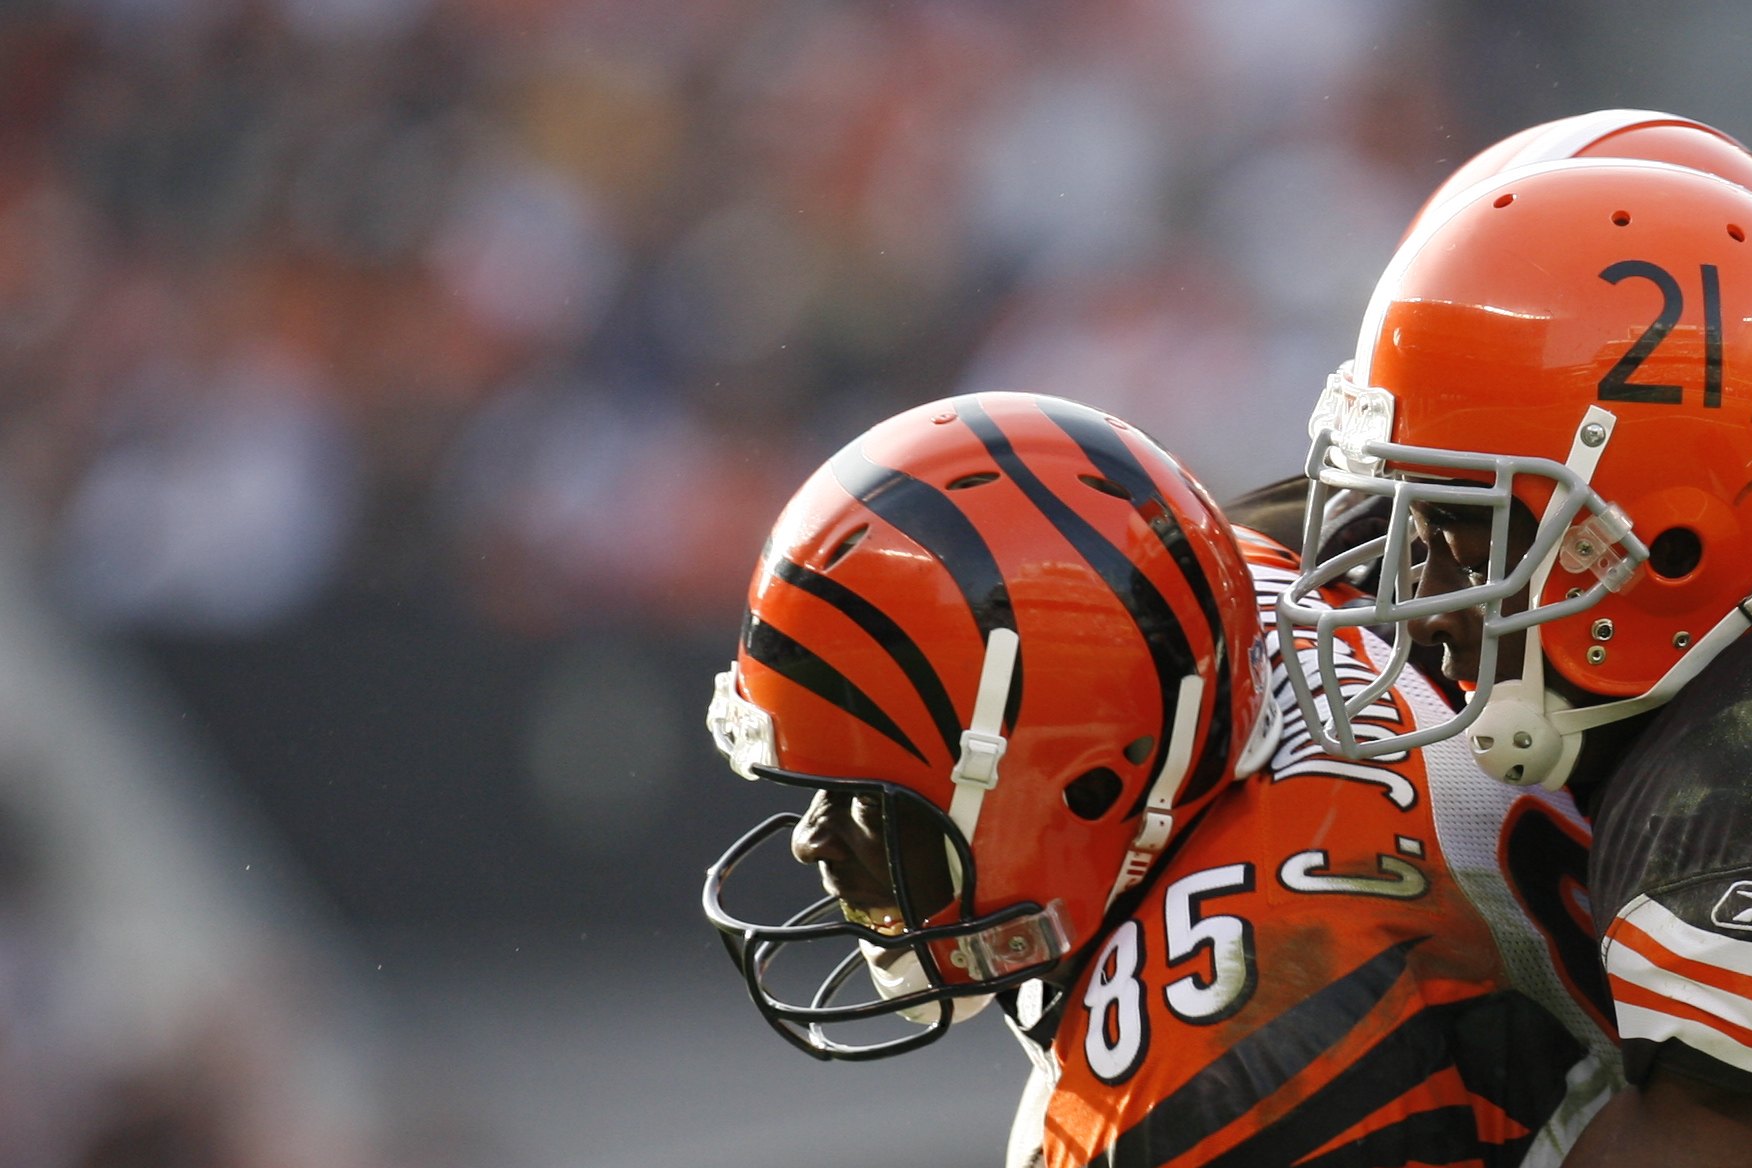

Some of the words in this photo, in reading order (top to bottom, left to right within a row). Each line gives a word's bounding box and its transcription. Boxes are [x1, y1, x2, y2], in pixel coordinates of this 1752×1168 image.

[1597, 260, 1723, 409] 21
[1275, 834, 1432, 900] C.
[1083, 861, 1259, 1087] 85
